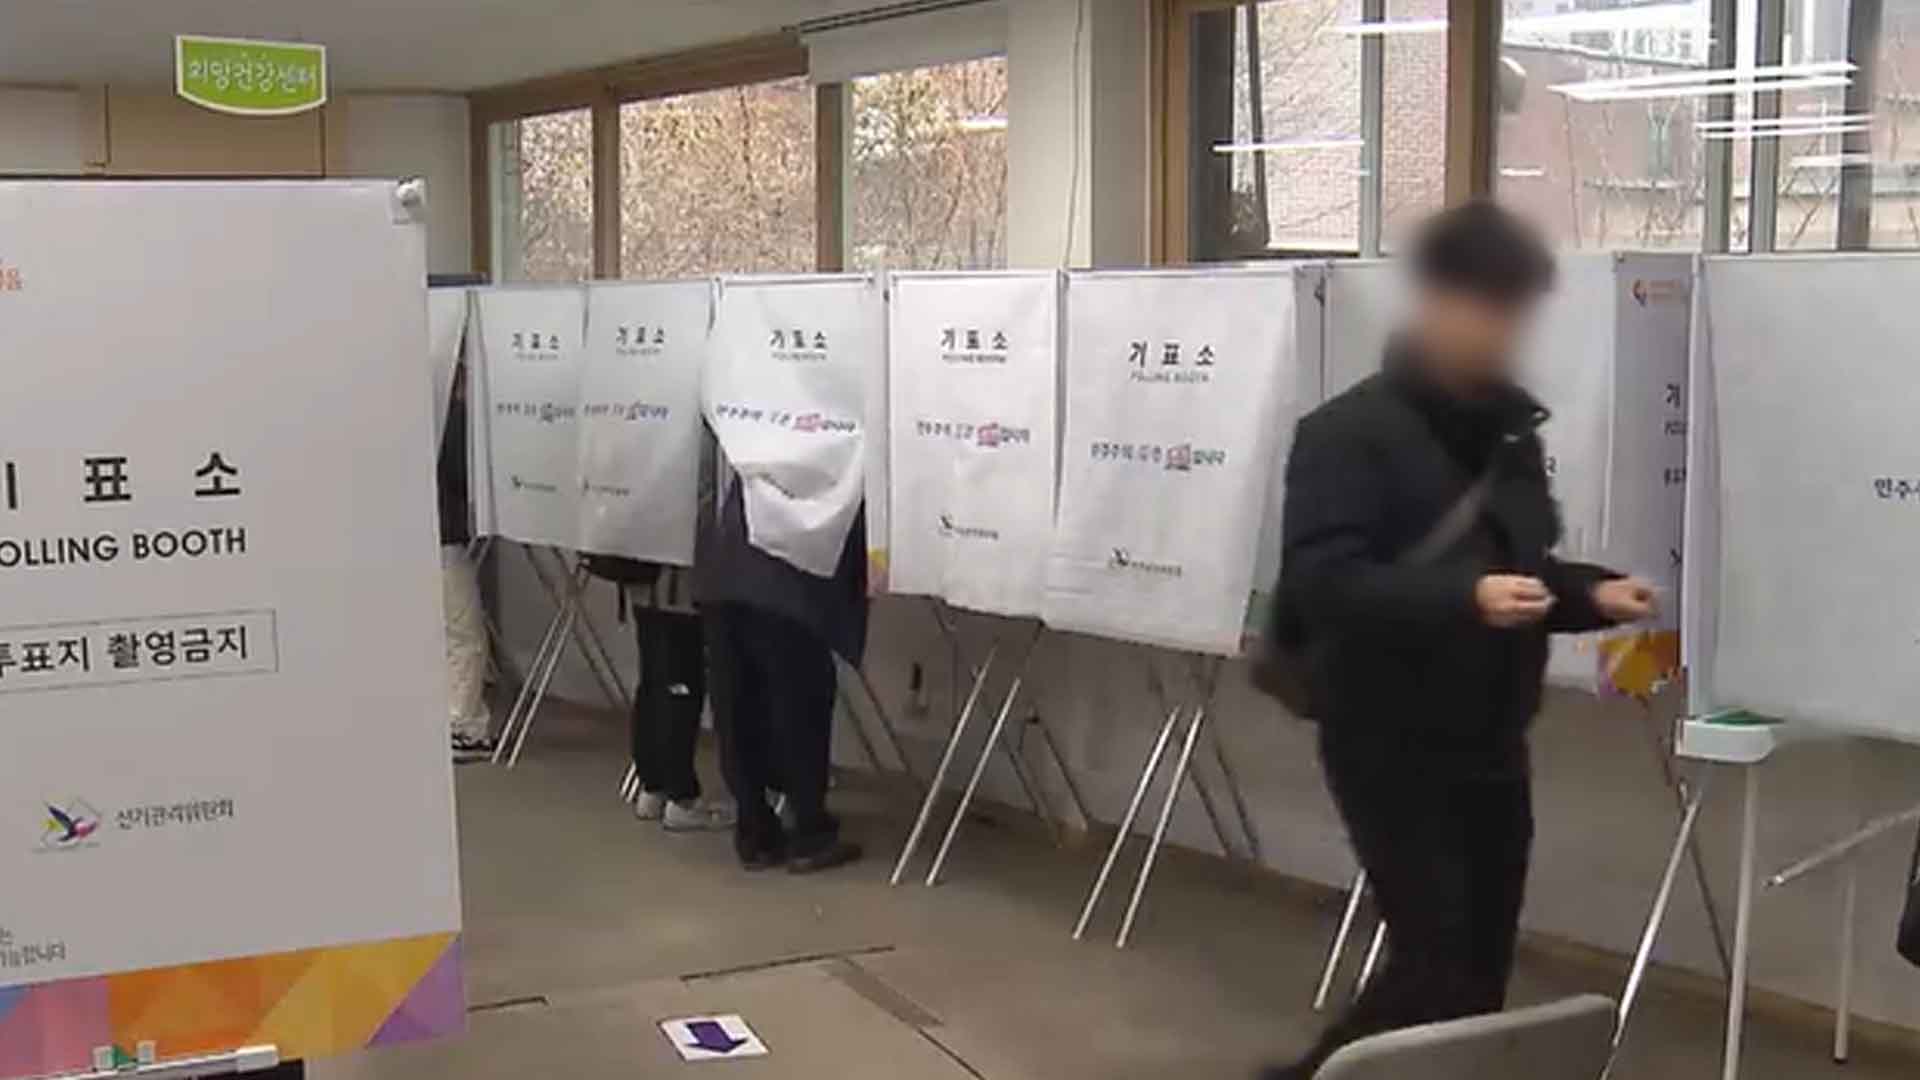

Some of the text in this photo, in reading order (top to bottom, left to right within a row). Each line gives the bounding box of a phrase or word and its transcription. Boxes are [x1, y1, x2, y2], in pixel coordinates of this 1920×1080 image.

[941, 328, 1008, 350] 기표소
[1129, 340, 1213, 368] 기표소
[132, 527, 247, 560] BOOTH
[107, 624, 248, 670] 촬영금지
